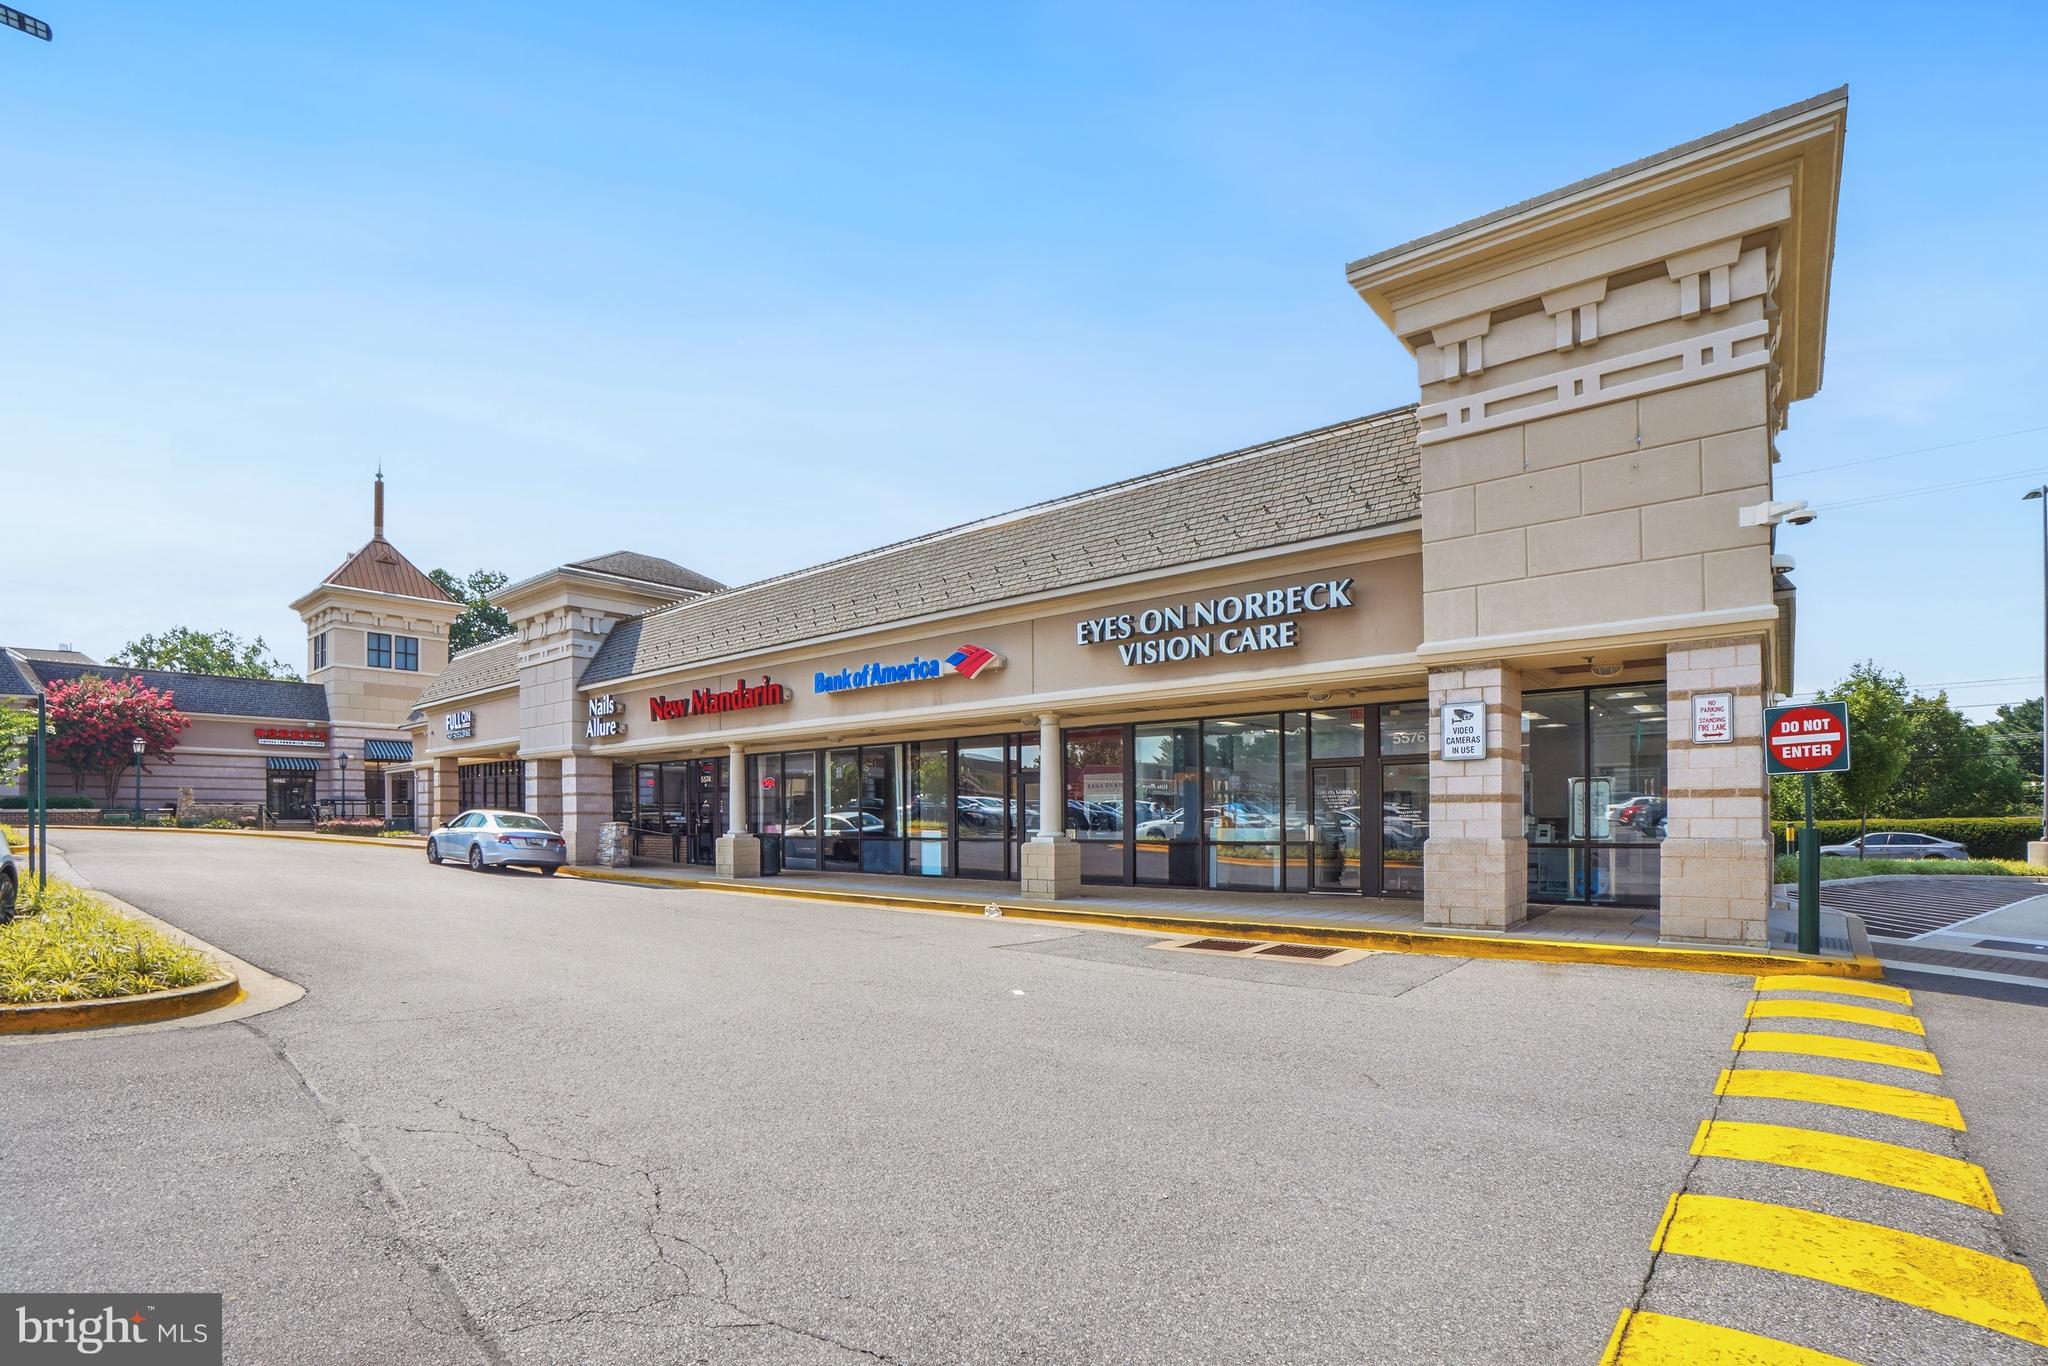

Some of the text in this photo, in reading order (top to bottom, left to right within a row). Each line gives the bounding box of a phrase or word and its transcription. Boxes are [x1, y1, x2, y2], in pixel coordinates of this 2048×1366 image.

[1076, 578, 1354, 646] EYES ON NORBECK
[1118, 621, 1297, 666] VISION CARE
[814, 656, 940, 694] Bank of America
[588, 694, 615, 717] Nails
[649, 675, 783, 722] New Mandarin
[446, 710, 472, 731] FULL ON
[586, 718, 617, 738] Allure
[1712, 723, 1727, 731] LANE
[1781, 718, 1831, 733] DO NOT
[1392, 731, 1426, 745] 5576
[1452, 726, 1474, 735] VIDEO
[1446, 735, 1481, 745] CAMERAS
[1451, 746, 1475, 754] IN USE
[1782, 744, 1833, 759] ENTER
